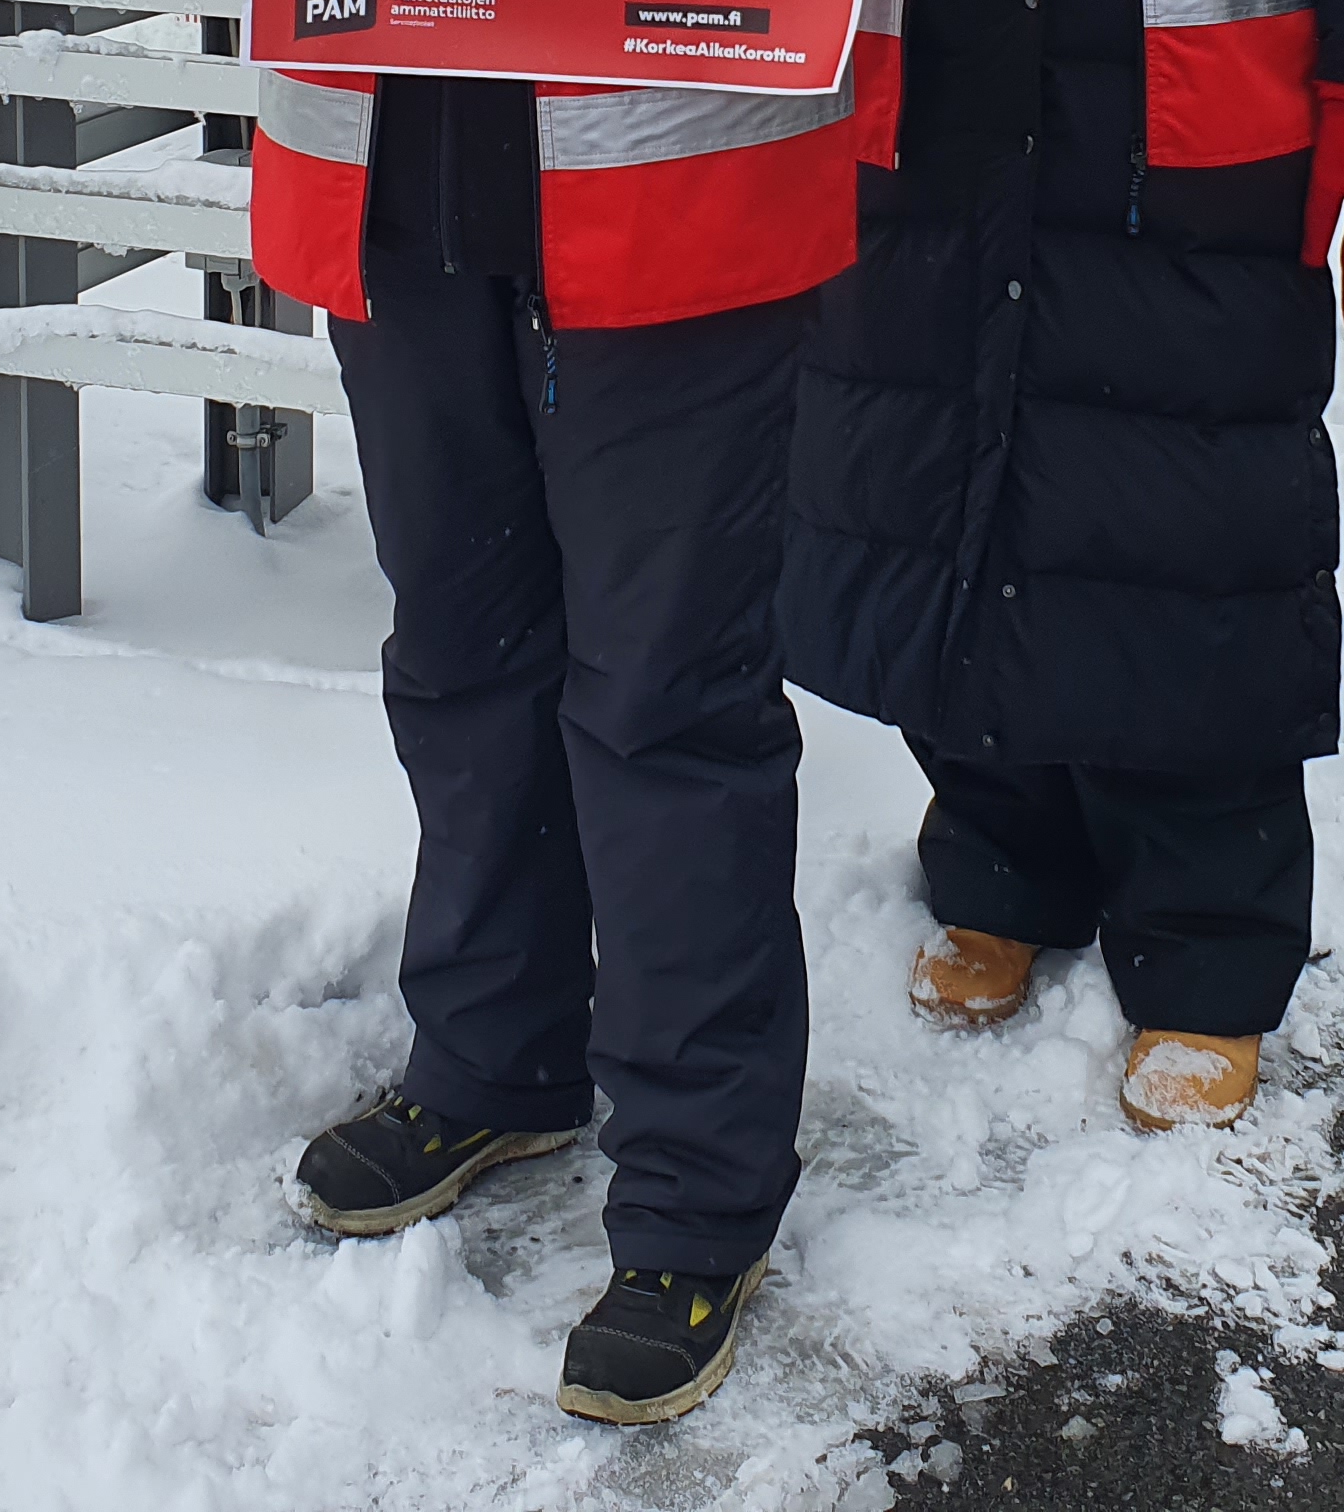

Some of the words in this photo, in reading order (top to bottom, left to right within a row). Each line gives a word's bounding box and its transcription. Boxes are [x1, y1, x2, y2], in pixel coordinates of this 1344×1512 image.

[391, 4, 495, 20] ammattiliitto
[639, 10, 741, 26] www.pam.fi
[624, 38, 805, 63] #KorkeaAikaKorottaa
